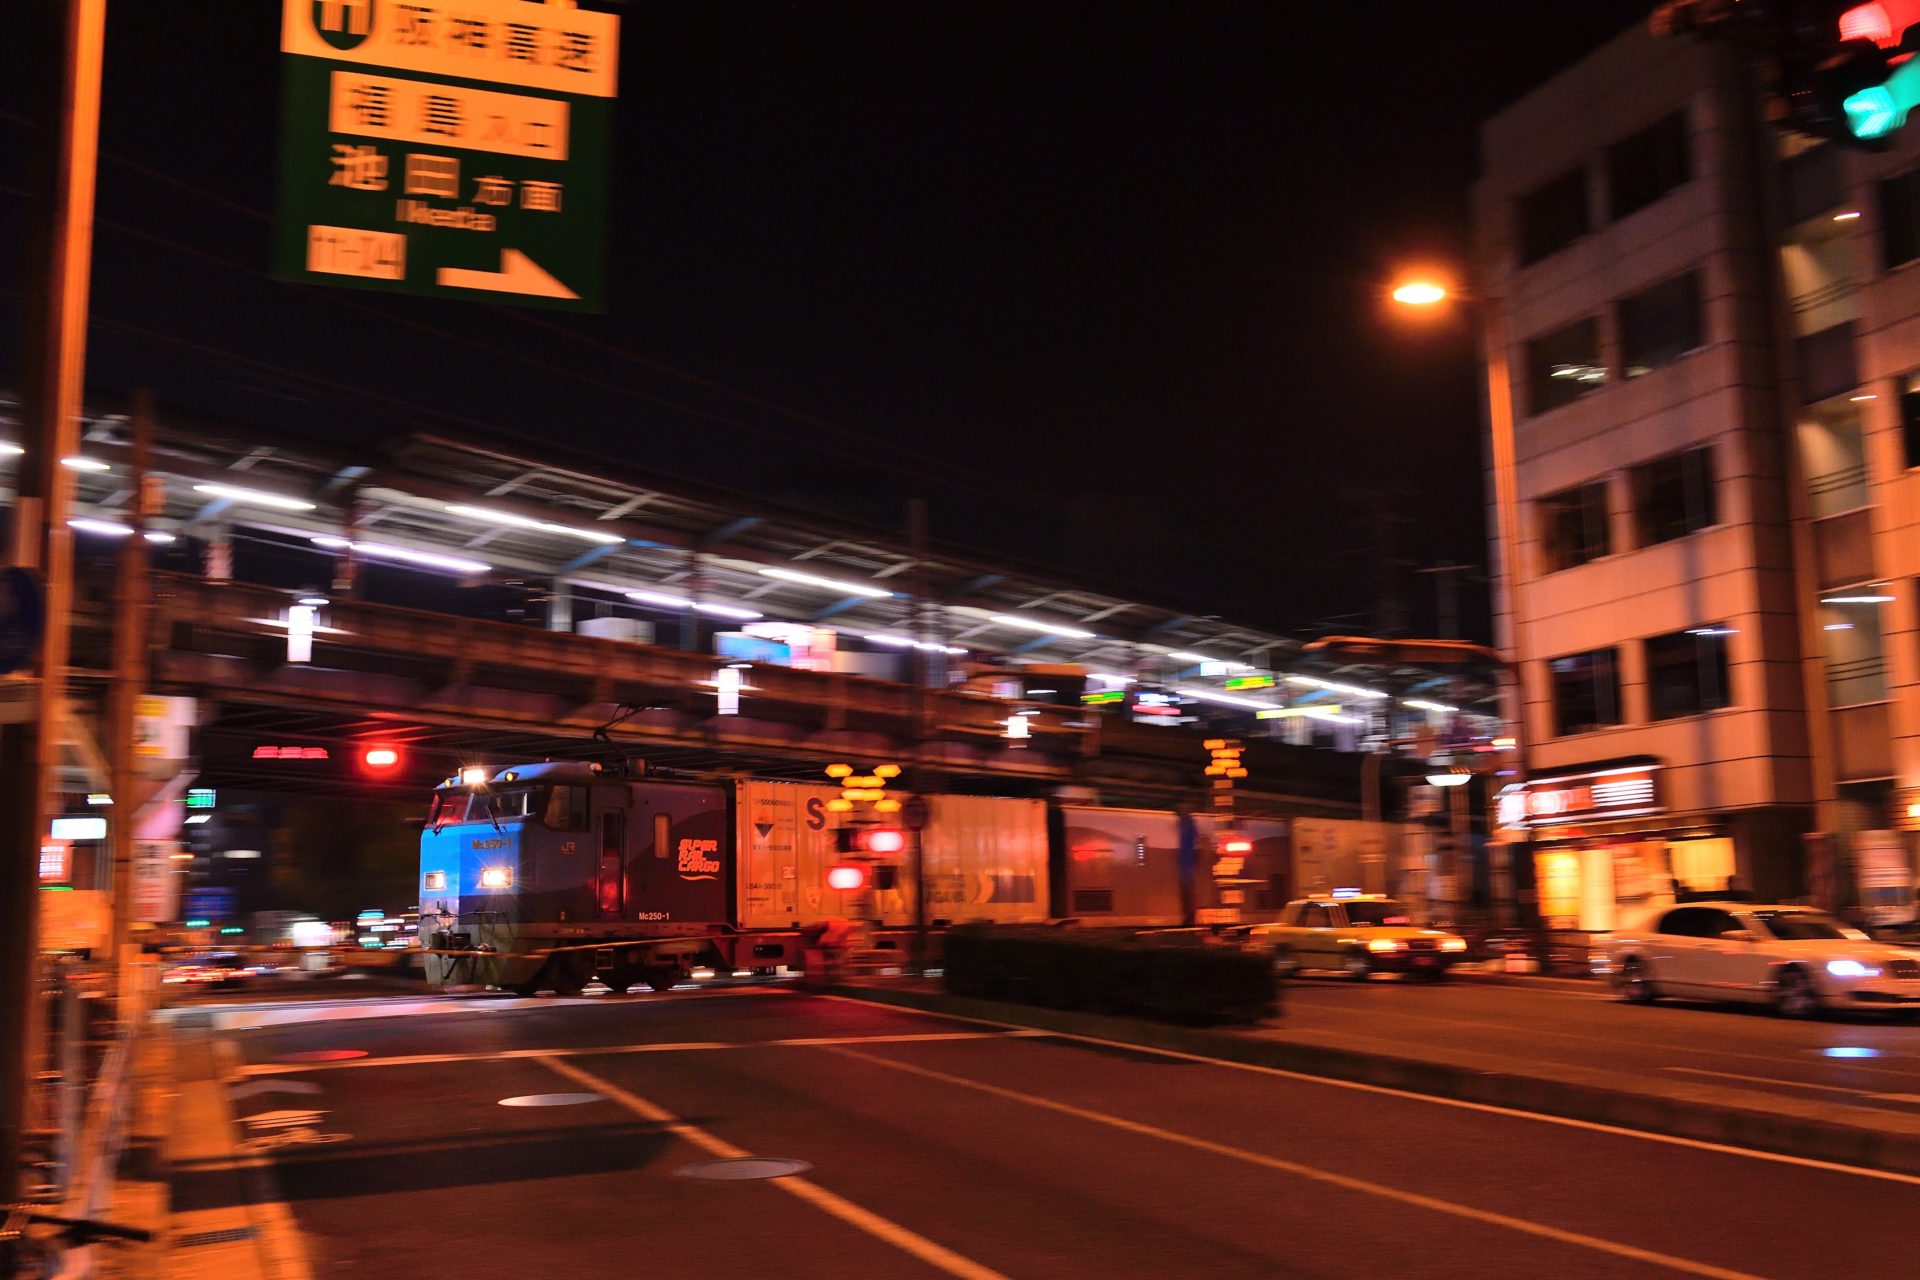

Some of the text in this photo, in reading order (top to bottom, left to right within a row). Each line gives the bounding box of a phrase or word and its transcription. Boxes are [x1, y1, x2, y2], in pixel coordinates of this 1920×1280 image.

[678, 838, 717, 852] SUPER
[678, 860, 720, 873] CARGO
[638, 912, 670, 921] Mc250-1
